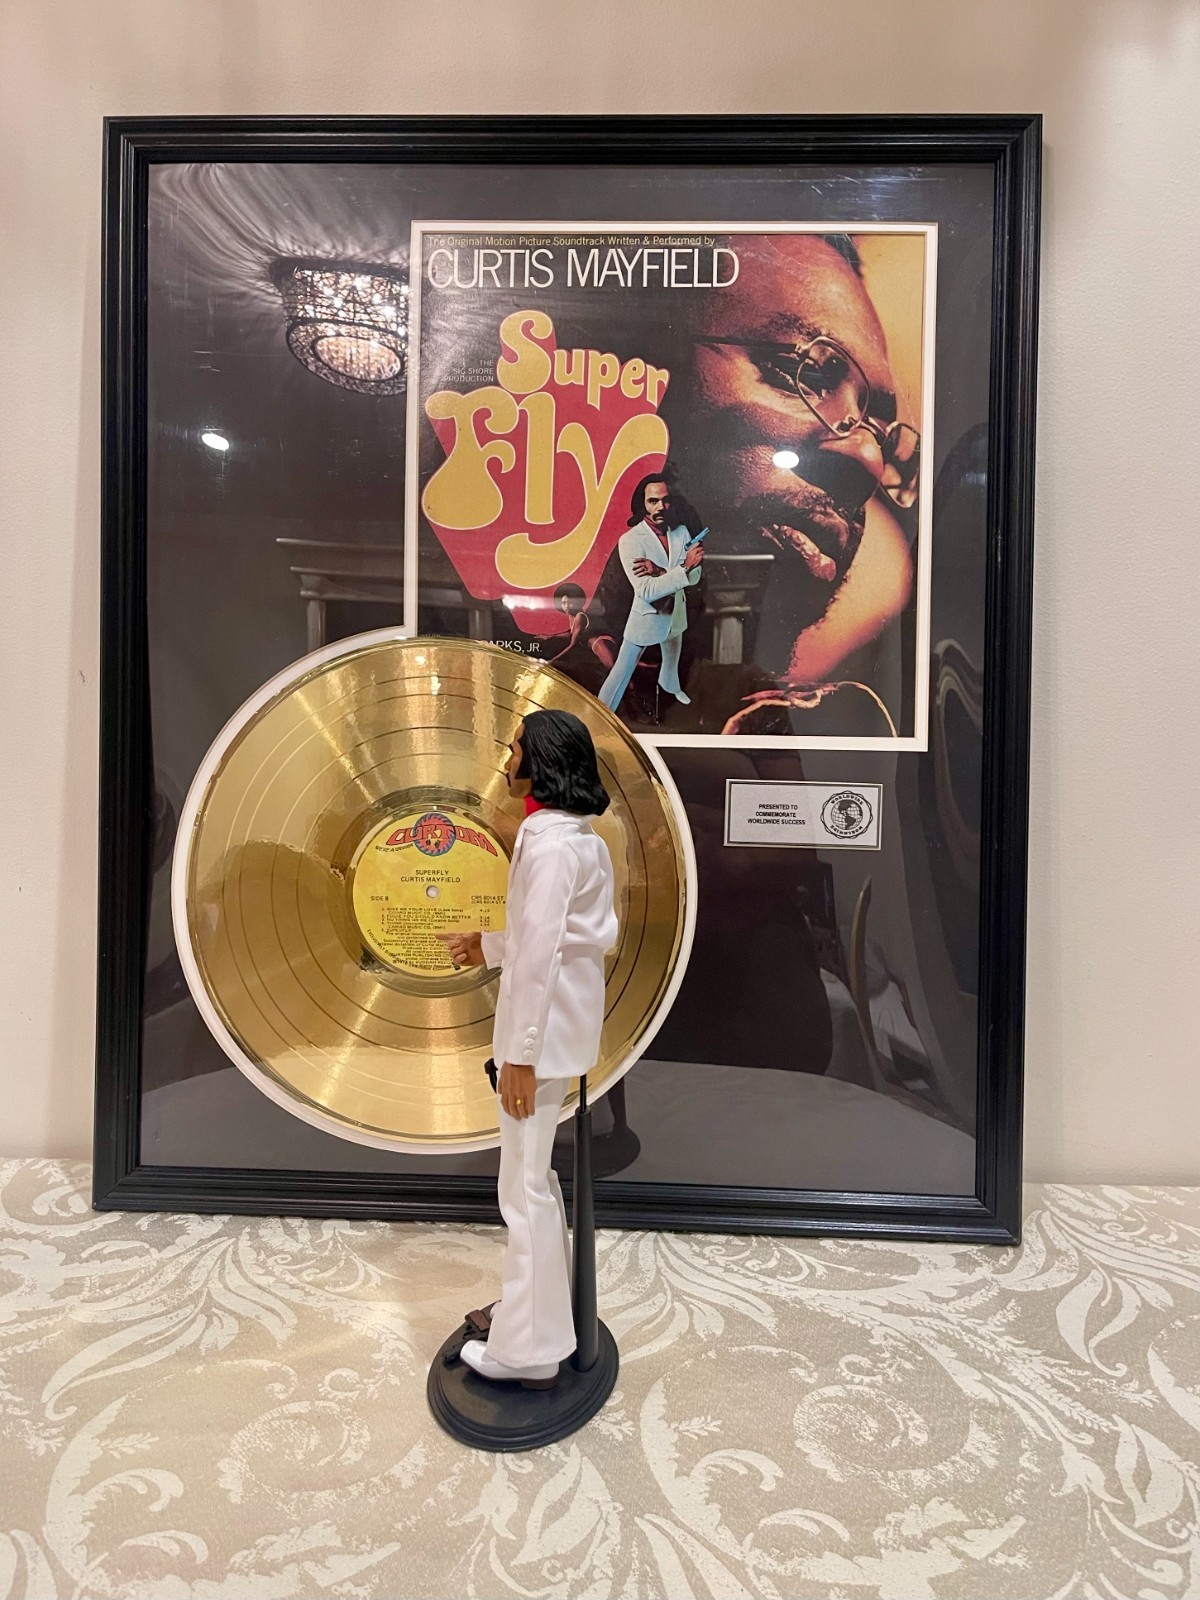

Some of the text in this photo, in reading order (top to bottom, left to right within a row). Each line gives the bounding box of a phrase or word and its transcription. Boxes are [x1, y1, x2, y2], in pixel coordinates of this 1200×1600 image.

[428, 236, 716, 248] The Original Motion Picture Soundtrack Written & Performed by
[428, 248, 740, 288] CURTIS MAYFIELD
[526, 642, 542, 652] JR.
[830, 794, 864, 805] WORLDWIDE
[386, 824, 498, 857] CURTOM
